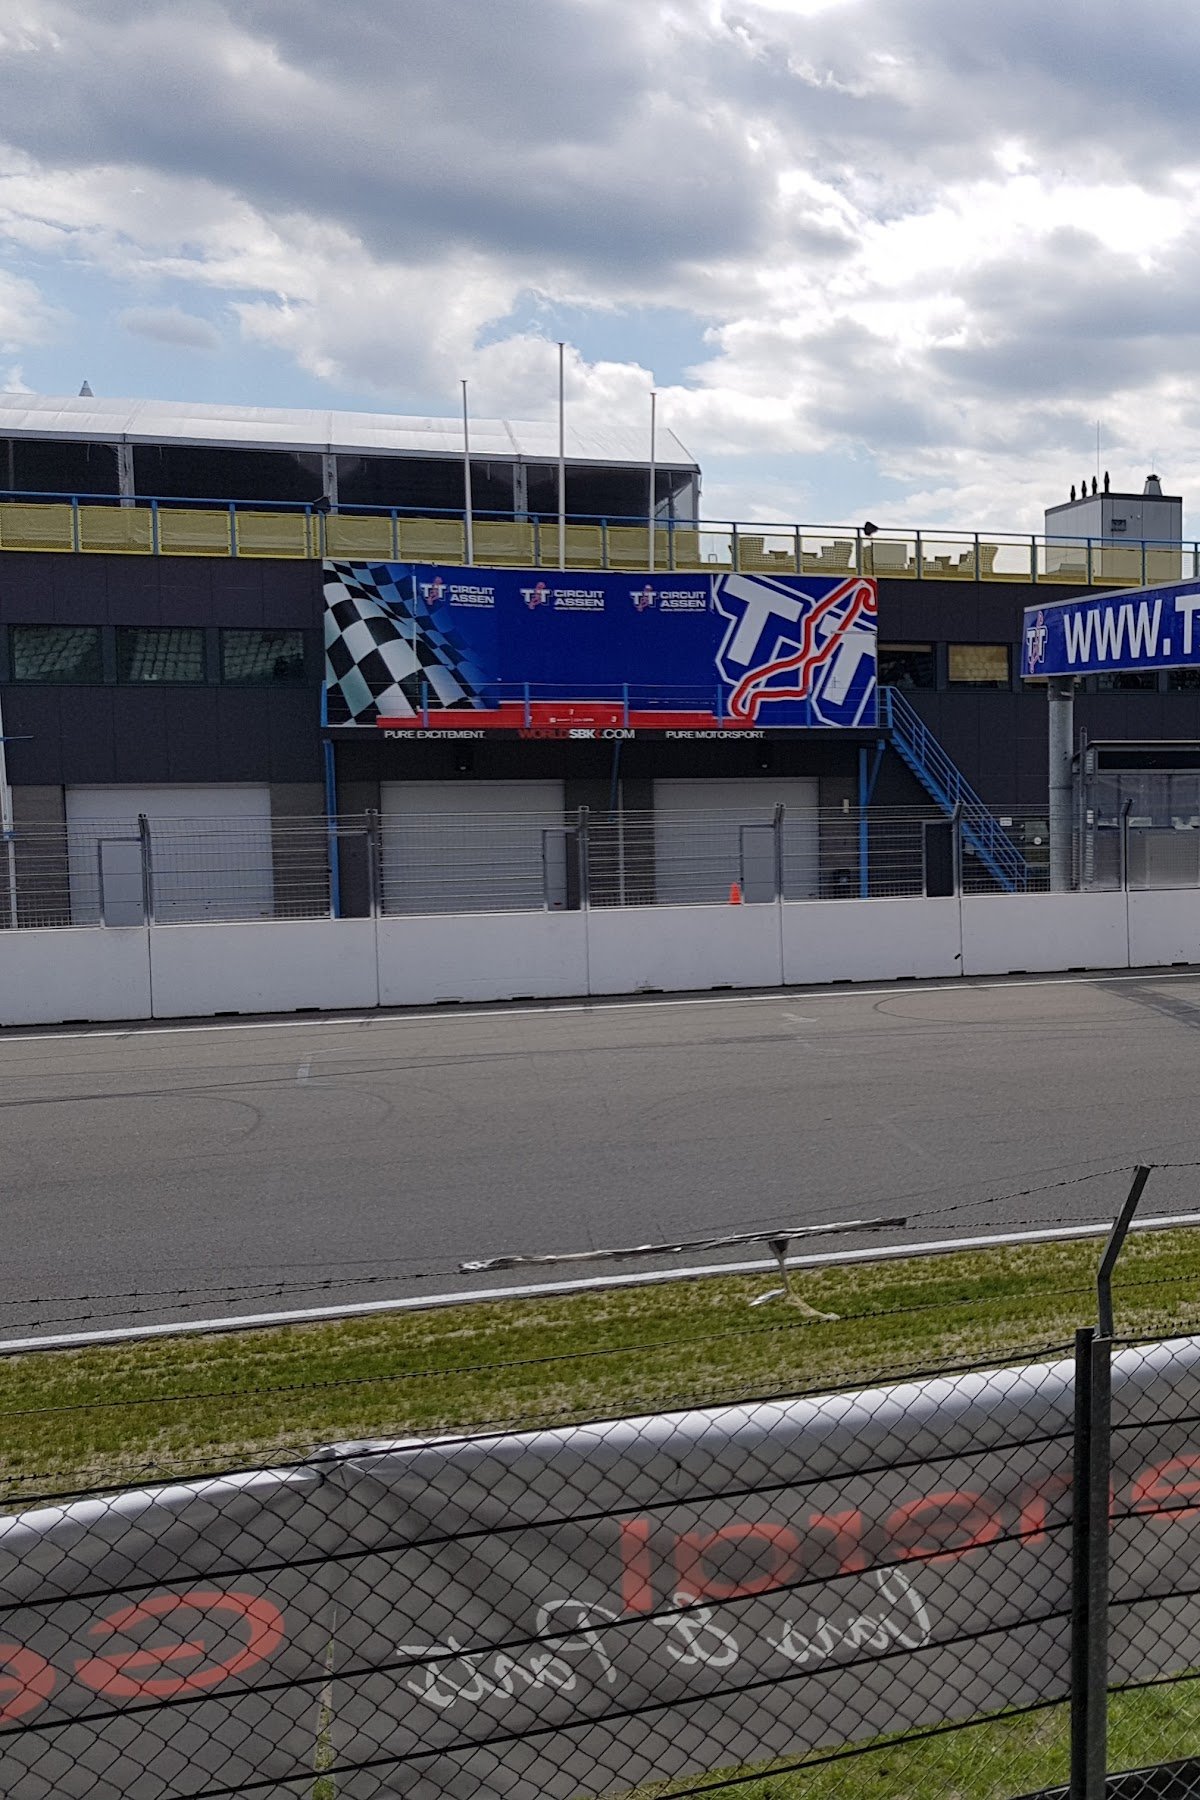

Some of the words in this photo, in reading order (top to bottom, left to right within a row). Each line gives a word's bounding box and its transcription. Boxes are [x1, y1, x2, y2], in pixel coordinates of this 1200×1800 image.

[449, 584, 495, 595] CIRCUIT
[554, 589, 605, 599] CIRCUIT
[449, 594, 495, 604] ASSEN
[660, 591, 707, 600] CIRCUIT
[554, 598, 605, 608] ASSEN
[660, 600, 707, 609] ASSEN
[384, 730, 415, 739] PURE
[665, 730, 695, 739] PURE
